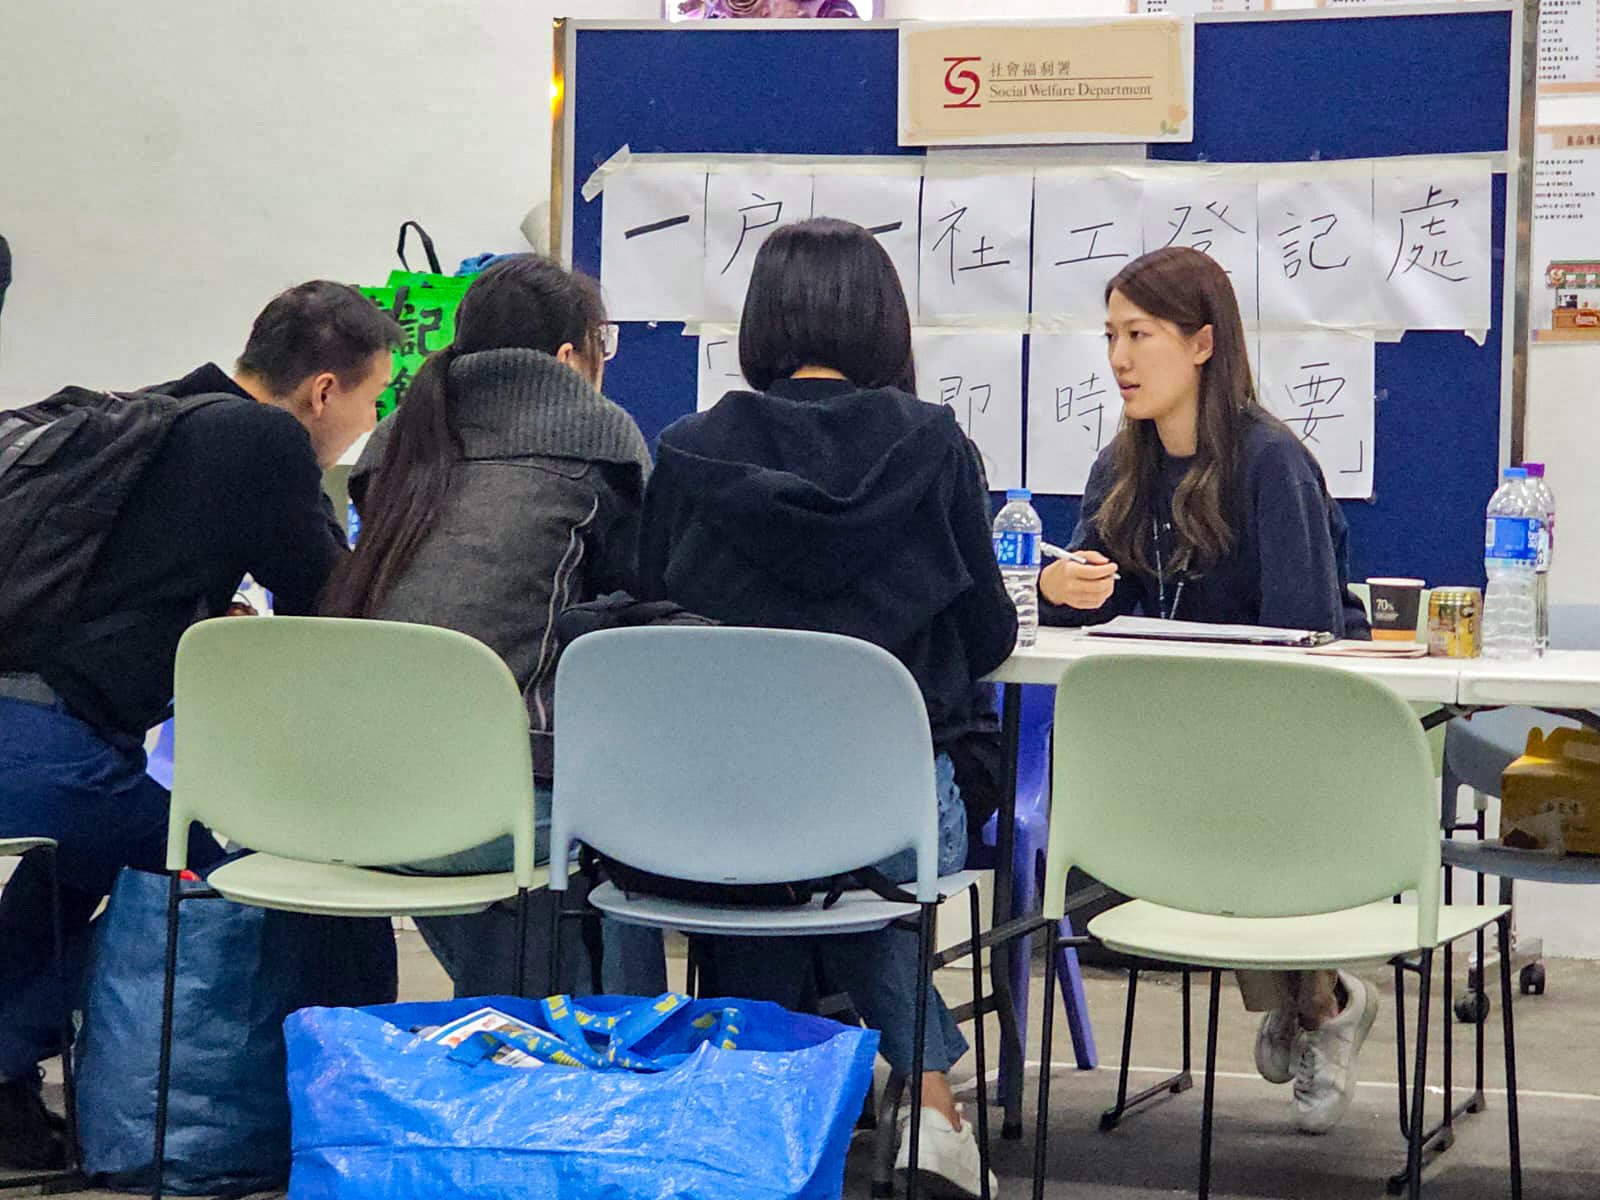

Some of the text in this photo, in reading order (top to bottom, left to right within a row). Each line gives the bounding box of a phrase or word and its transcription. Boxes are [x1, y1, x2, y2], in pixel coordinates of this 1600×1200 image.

[990, 60, 1071, 77] 社會福利署
[990, 82, 1151, 99] Social Welfare Department
